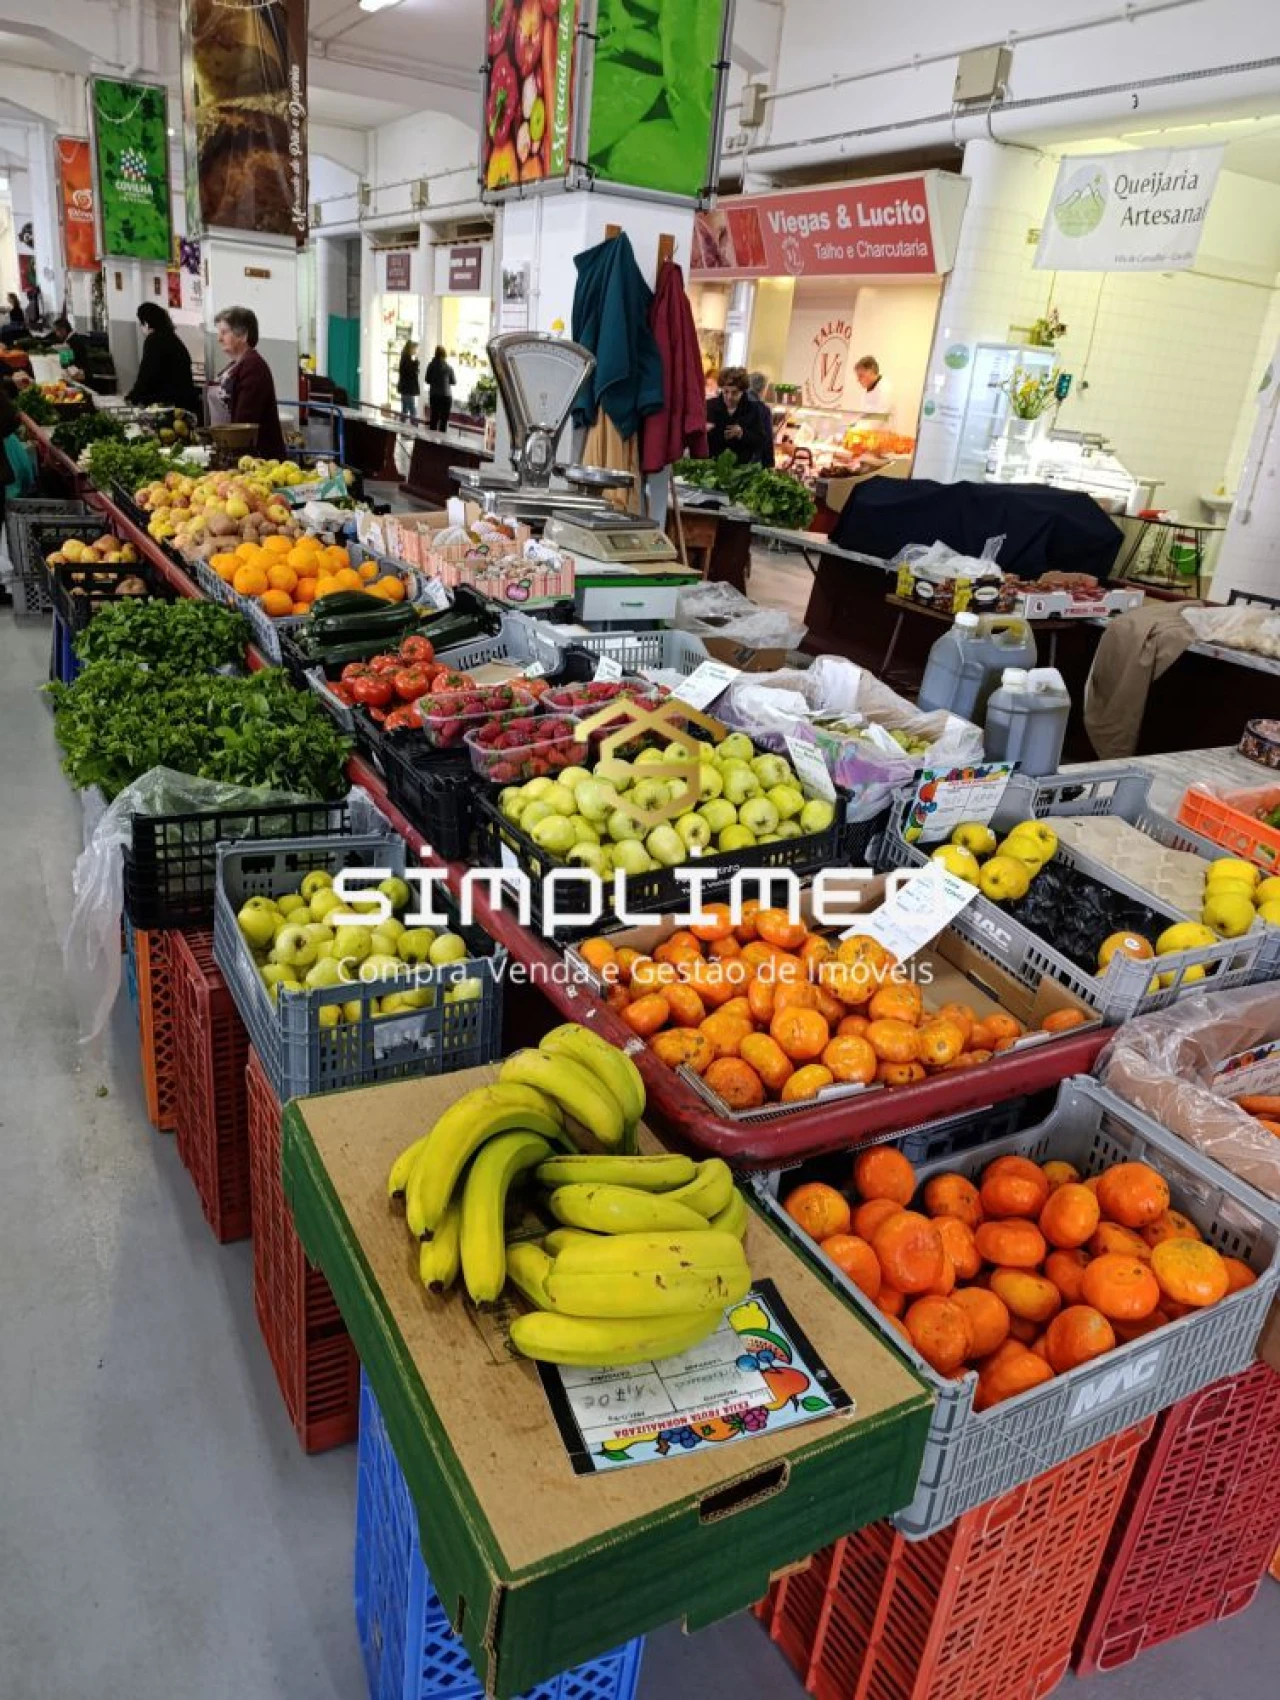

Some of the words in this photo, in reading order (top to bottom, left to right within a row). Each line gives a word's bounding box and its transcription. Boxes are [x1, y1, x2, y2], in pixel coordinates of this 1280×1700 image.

[1114, 170, 1200, 200] Queijaria
[767, 208, 831, 237] Viegas
[836, 203, 852, 230] &
[856, 199, 926, 227] Lucito
[1120, 198, 1210, 227] Artesanal
[814, 242, 844, 259] Talho
[846, 245, 854, 258] e
[856, 238, 928, 258] Charcutaria
[813, 319, 853, 348] TALHO
[1071, 1349, 1160, 1417] MAC
[614, 1416, 687, 1438] NORMALIZADA
